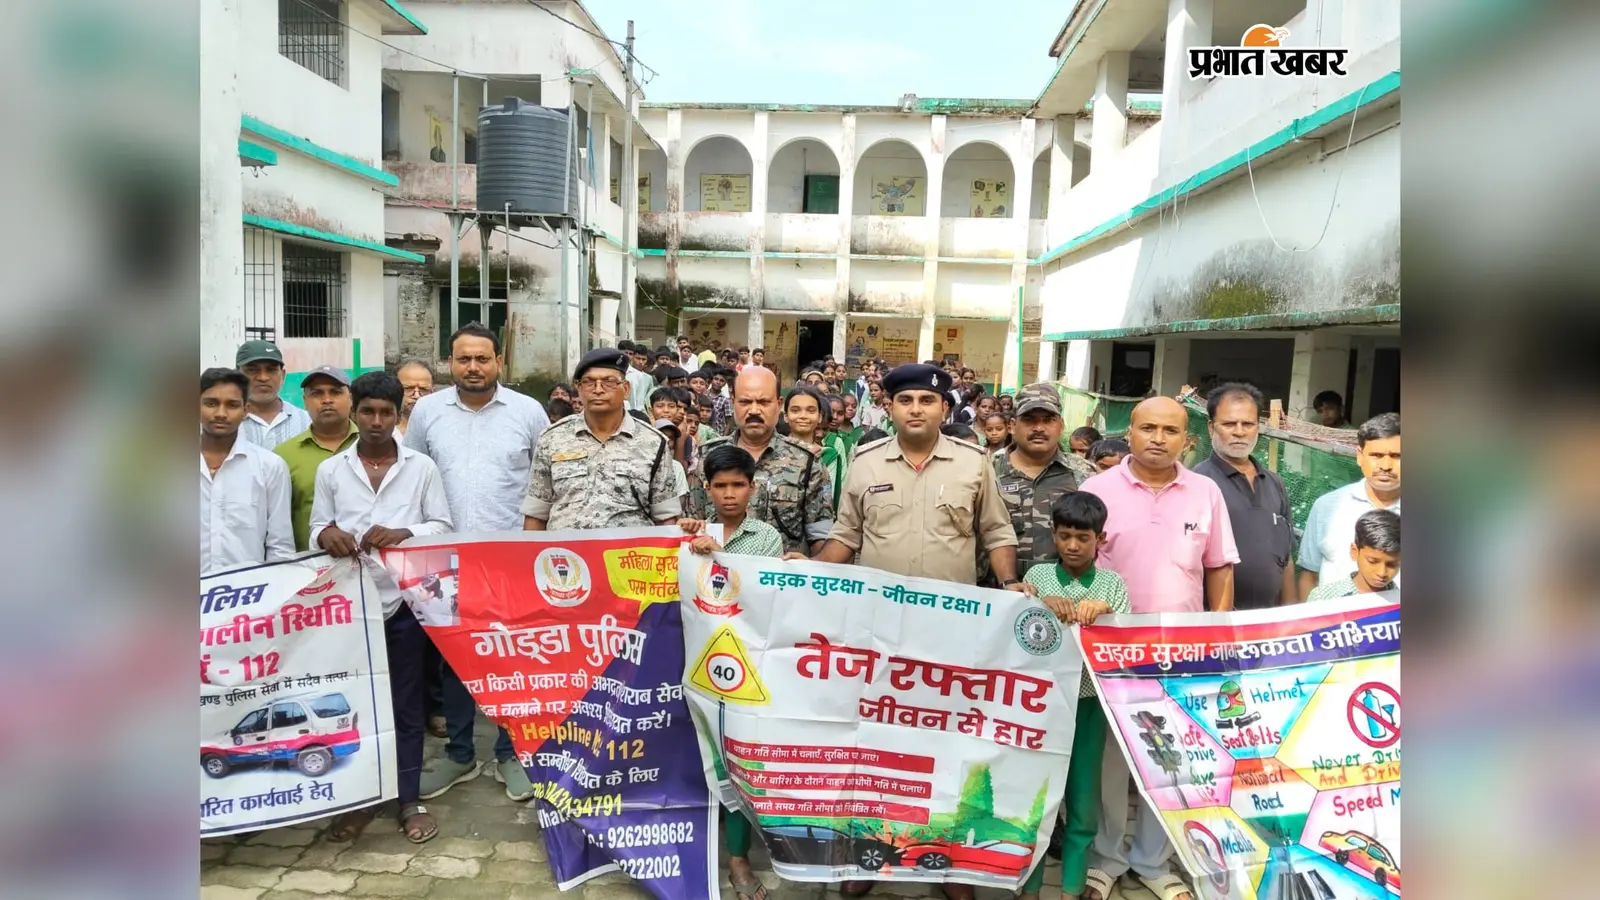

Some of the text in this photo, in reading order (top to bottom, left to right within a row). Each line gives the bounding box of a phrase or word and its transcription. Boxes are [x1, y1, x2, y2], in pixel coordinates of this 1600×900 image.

[758, 570, 808, 591] सड़क
[810, 574, 865, 597] सुरक्षा
[882, 584, 939, 608] जीवन
[941, 594, 980, 615] रक्षा
[281, 594, 354, 636] स्थिति
[470, 613, 647, 666] गोड्डा पुलिस
[1092, 641, 1148, 669] सड़क
[1150, 641, 1207, 671] सुरक्षा
[1319, 619, 1400, 651] अभिया
[238, 651, 280, 682] 112
[713, 665, 736, 682] 40
[794, 632, 1053, 713] तेज रफ्तार
[224, 687, 257, 707] पुलिस
[260, 682, 280, 696] सेवा
[284, 676, 293, 690] में
[297, 672, 321, 689] सदैव
[486, 671, 526, 692] किसी
[528, 673, 568, 691] प्रकार
[569, 668, 589, 689] की
[656, 682, 683, 703] सेव
[1184, 677, 1306, 711] Use Helmet
[859, 695, 1047, 750] जीवन से हार
[521, 721, 592, 747] Helpline
[606, 738, 645, 761] 112
[605, 769, 624, 786] के
[628, 766, 660, 784] लिए
[1312, 754, 1361, 773] Never
[1319, 764, 1400, 787] And Driv
[1252, 791, 1285, 811] Road
[1332, 785, 1383, 818] Speed
[607, 821, 694, 849] 9262998682
